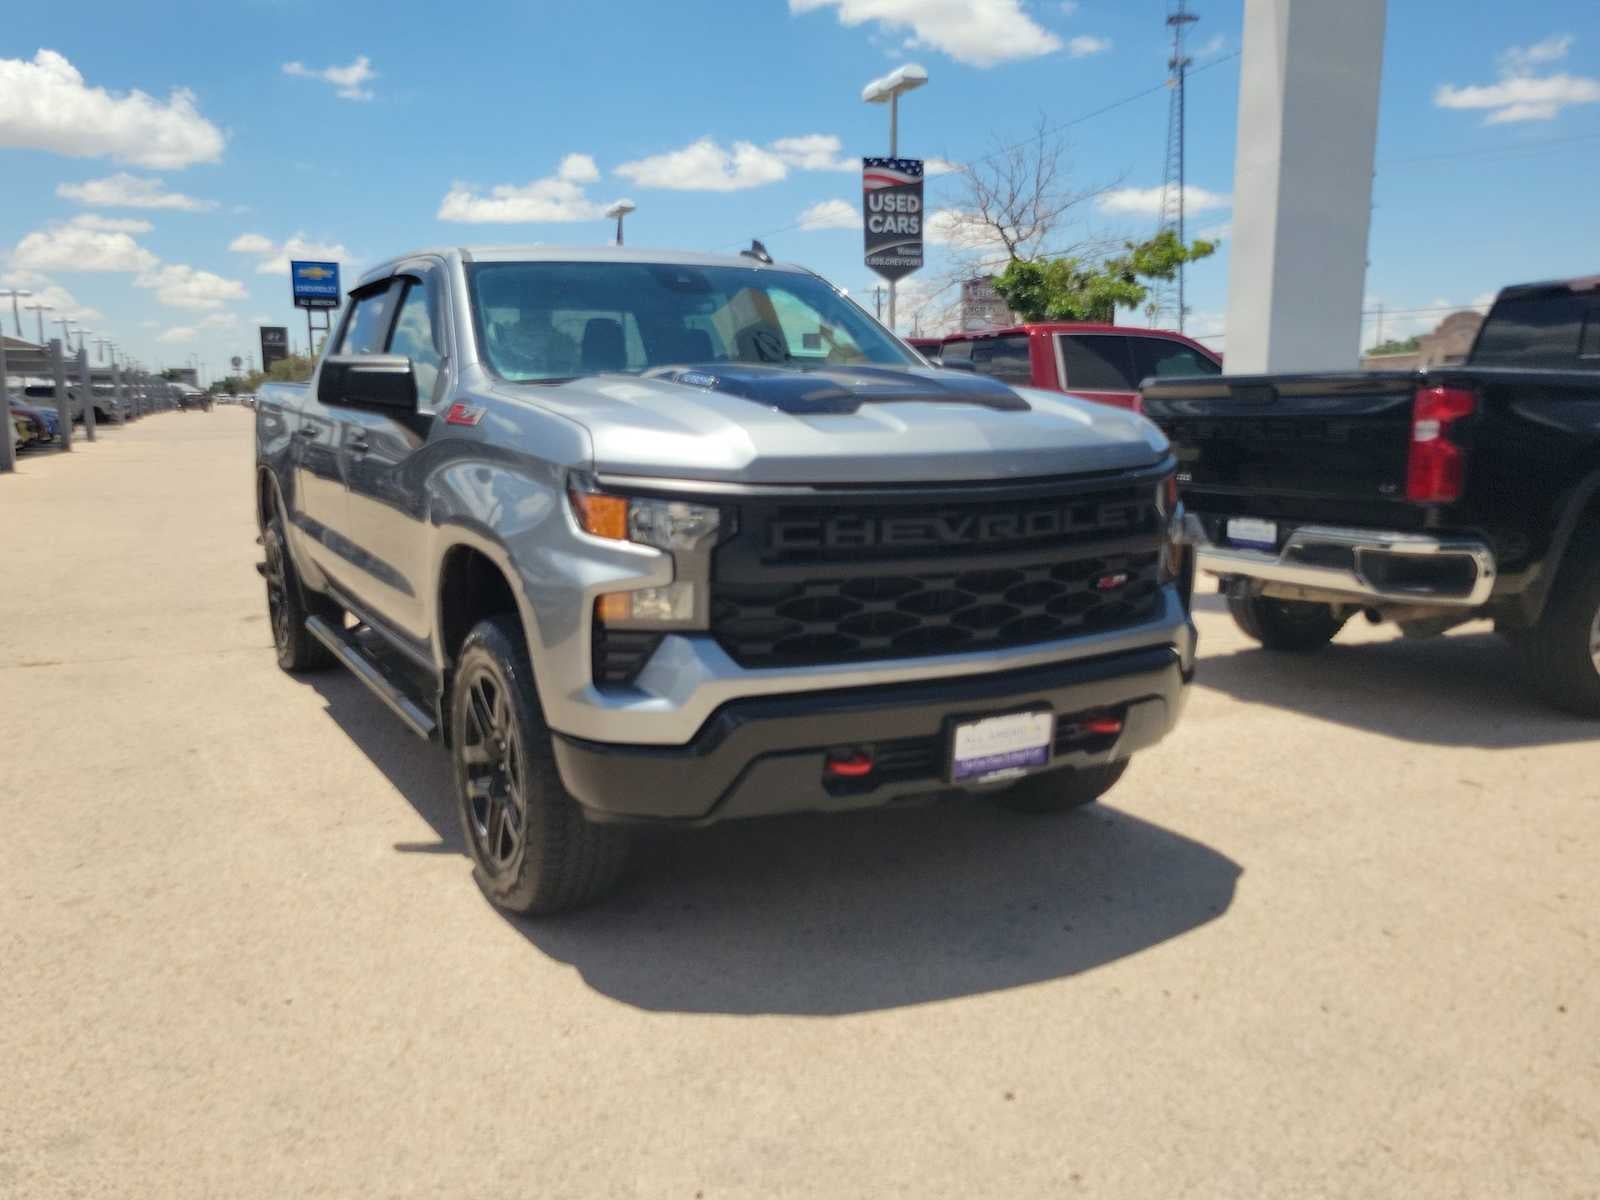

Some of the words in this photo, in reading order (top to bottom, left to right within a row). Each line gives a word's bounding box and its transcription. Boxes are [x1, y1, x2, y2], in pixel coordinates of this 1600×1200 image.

[868, 194, 920, 213] USED
[868, 215, 920, 234] CARS
[772, 501, 1155, 547] CHEVROLET
